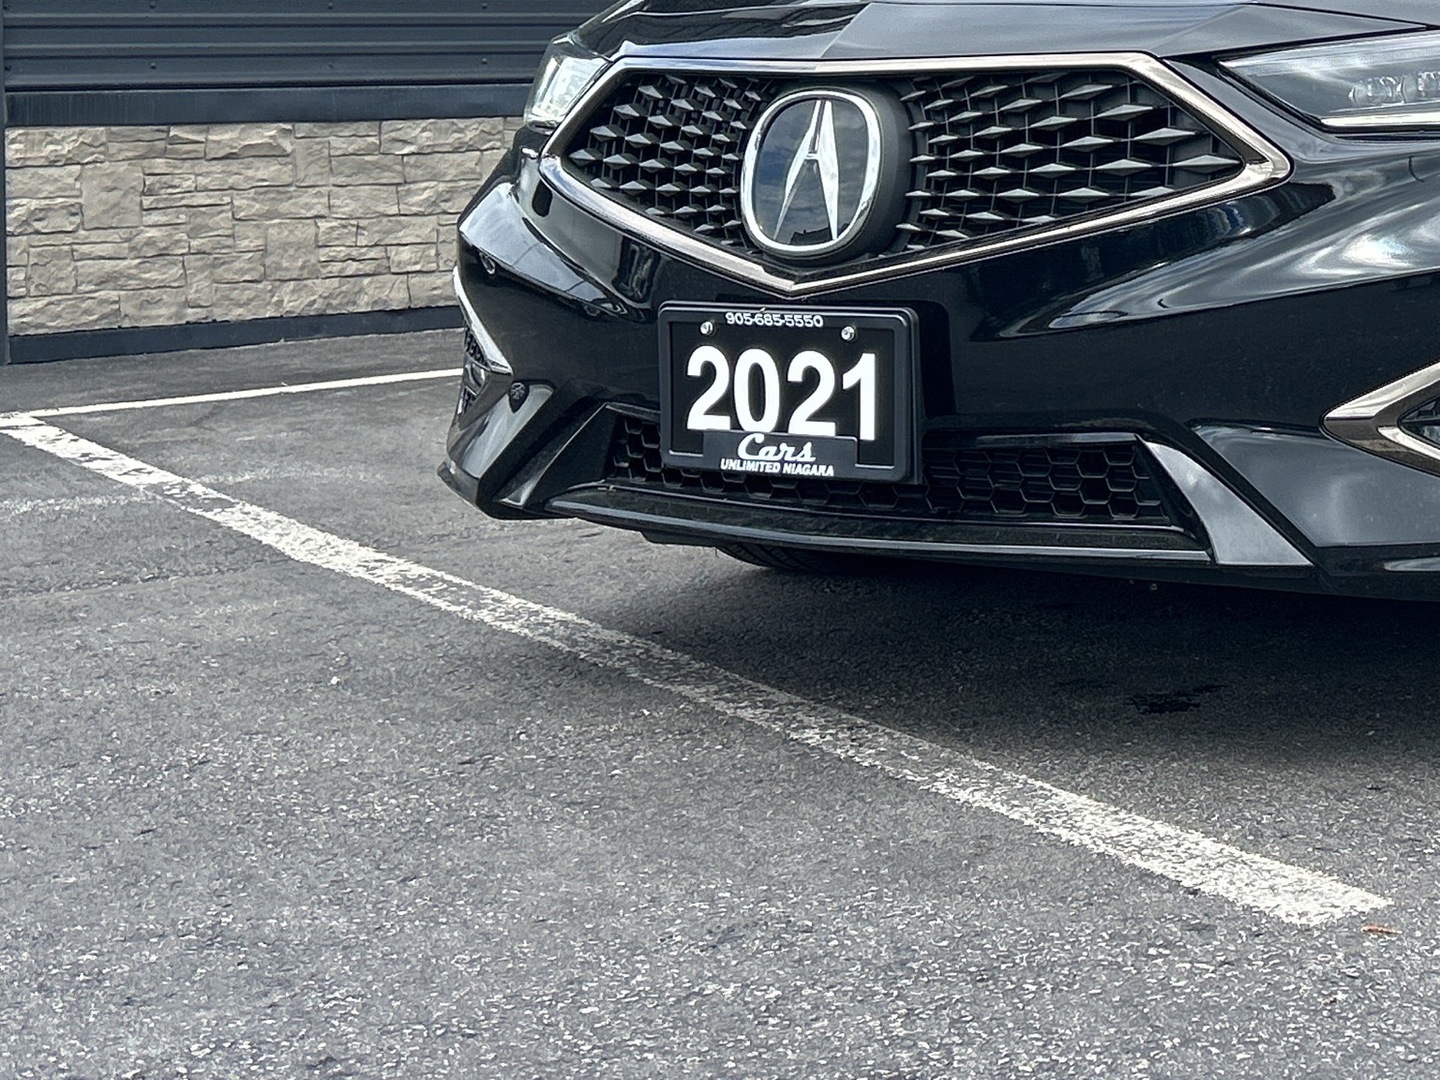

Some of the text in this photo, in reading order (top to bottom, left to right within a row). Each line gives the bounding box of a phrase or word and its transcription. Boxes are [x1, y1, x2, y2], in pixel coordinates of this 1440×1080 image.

[686, 345, 876, 441] 2021
[737, 433, 816, 461] Cars
[720, 458, 834, 477] UNLIMITED NIAGARA
